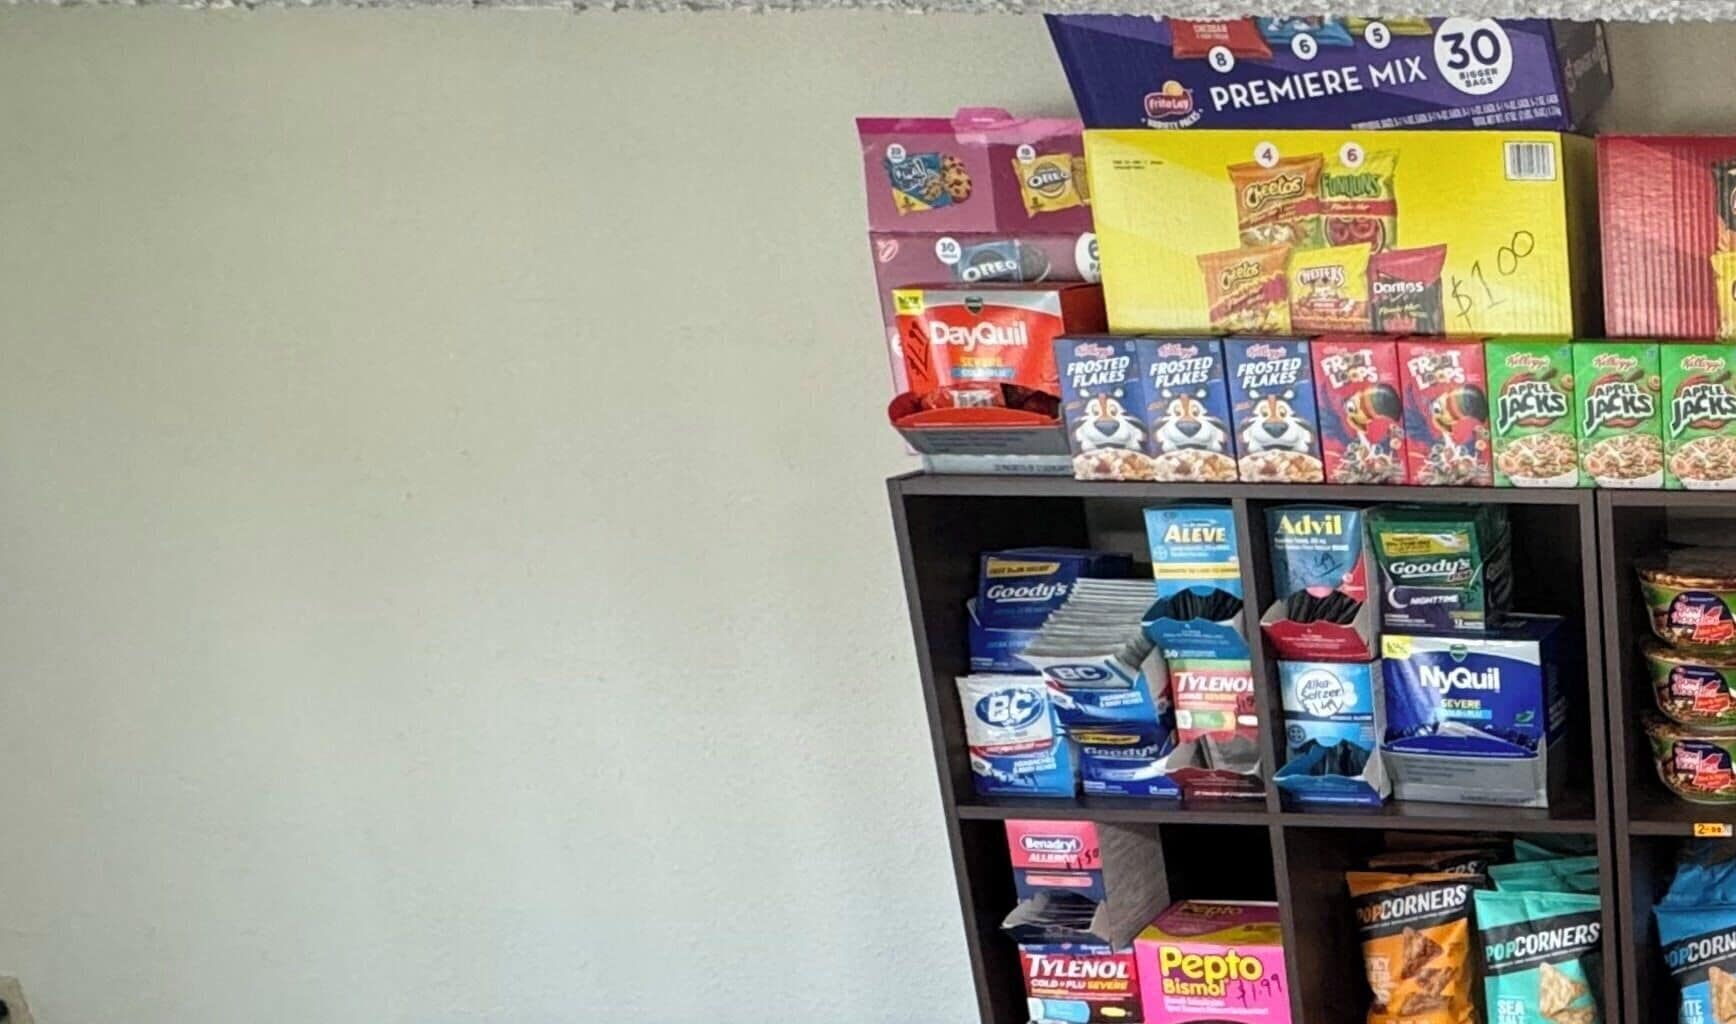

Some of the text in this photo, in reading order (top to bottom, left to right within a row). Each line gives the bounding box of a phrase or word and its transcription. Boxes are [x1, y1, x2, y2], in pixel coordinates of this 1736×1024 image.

[1371, 27, 1383, 43] 5
[1298, 39, 1311, 53] 6
[1441, 28, 1502, 69] 30
[1215, 52, 1228, 67] 8
[1459, 67, 1498, 79] BIGGER
[1210, 66, 1362, 112] PREMIERE
[1372, 56, 1427, 89] MIX
[1465, 77, 1494, 88] BAGS
[1261, 148, 1272, 162] 4
[1347, 149, 1357, 162] 6
[1244, 173, 1306, 206] Cheetos
[962, 259, 1018, 281] OREO
[1373, 280, 1424, 294] Doritos
[929, 320, 1028, 352] DayQuil
[1067, 357, 1130, 375] FROSTED
[1150, 357, 1213, 375] FROSTED
[1238, 357, 1301, 376] FROSTED
[1322, 349, 1371, 374] FROOT
[1407, 350, 1460, 375] FROOT
[1072, 370, 1126, 388] FLAKES
[1155, 371, 1209, 388] FLAKES
[1242, 371, 1296, 389] FLAKES
[1329, 368, 1378, 390] LOOPS
[1416, 368, 1464, 390] LOOPS
[1508, 383, 1551, 399] APPLE
[1596, 383, 1637, 399] APPLE
[1681, 384, 1724, 400] APPLE
[1498, 393, 1567, 433] JACKS
[1585, 393, 1653, 434] JACKS
[1277, 514, 1342, 535] Advil
[1164, 525, 1226, 543] ALEVE
[1390, 557, 1470, 576] Goody's
[987, 582, 1069, 600] Goody's
[1057, 666, 1098, 680] BC
[1420, 665, 1500, 694] NyQuil
[987, 695, 1033, 724] BC
[1025, 837, 1077, 852] Benadryl
[1357, 884, 1467, 924] POPCORNERS
[1485, 922, 1600, 961] POPCORNERS
[1025, 953, 1130, 979] TYLENOL
[1158, 946, 1264, 984] Pepto
[1030, 979, 1058, 989] COLD
[1066, 980, 1087, 990] FLU
[1087, 980, 1128, 990] SEVERE
[1162, 977, 1225, 998] Bismol
[1497, 1000, 1525, 1017] SEA
